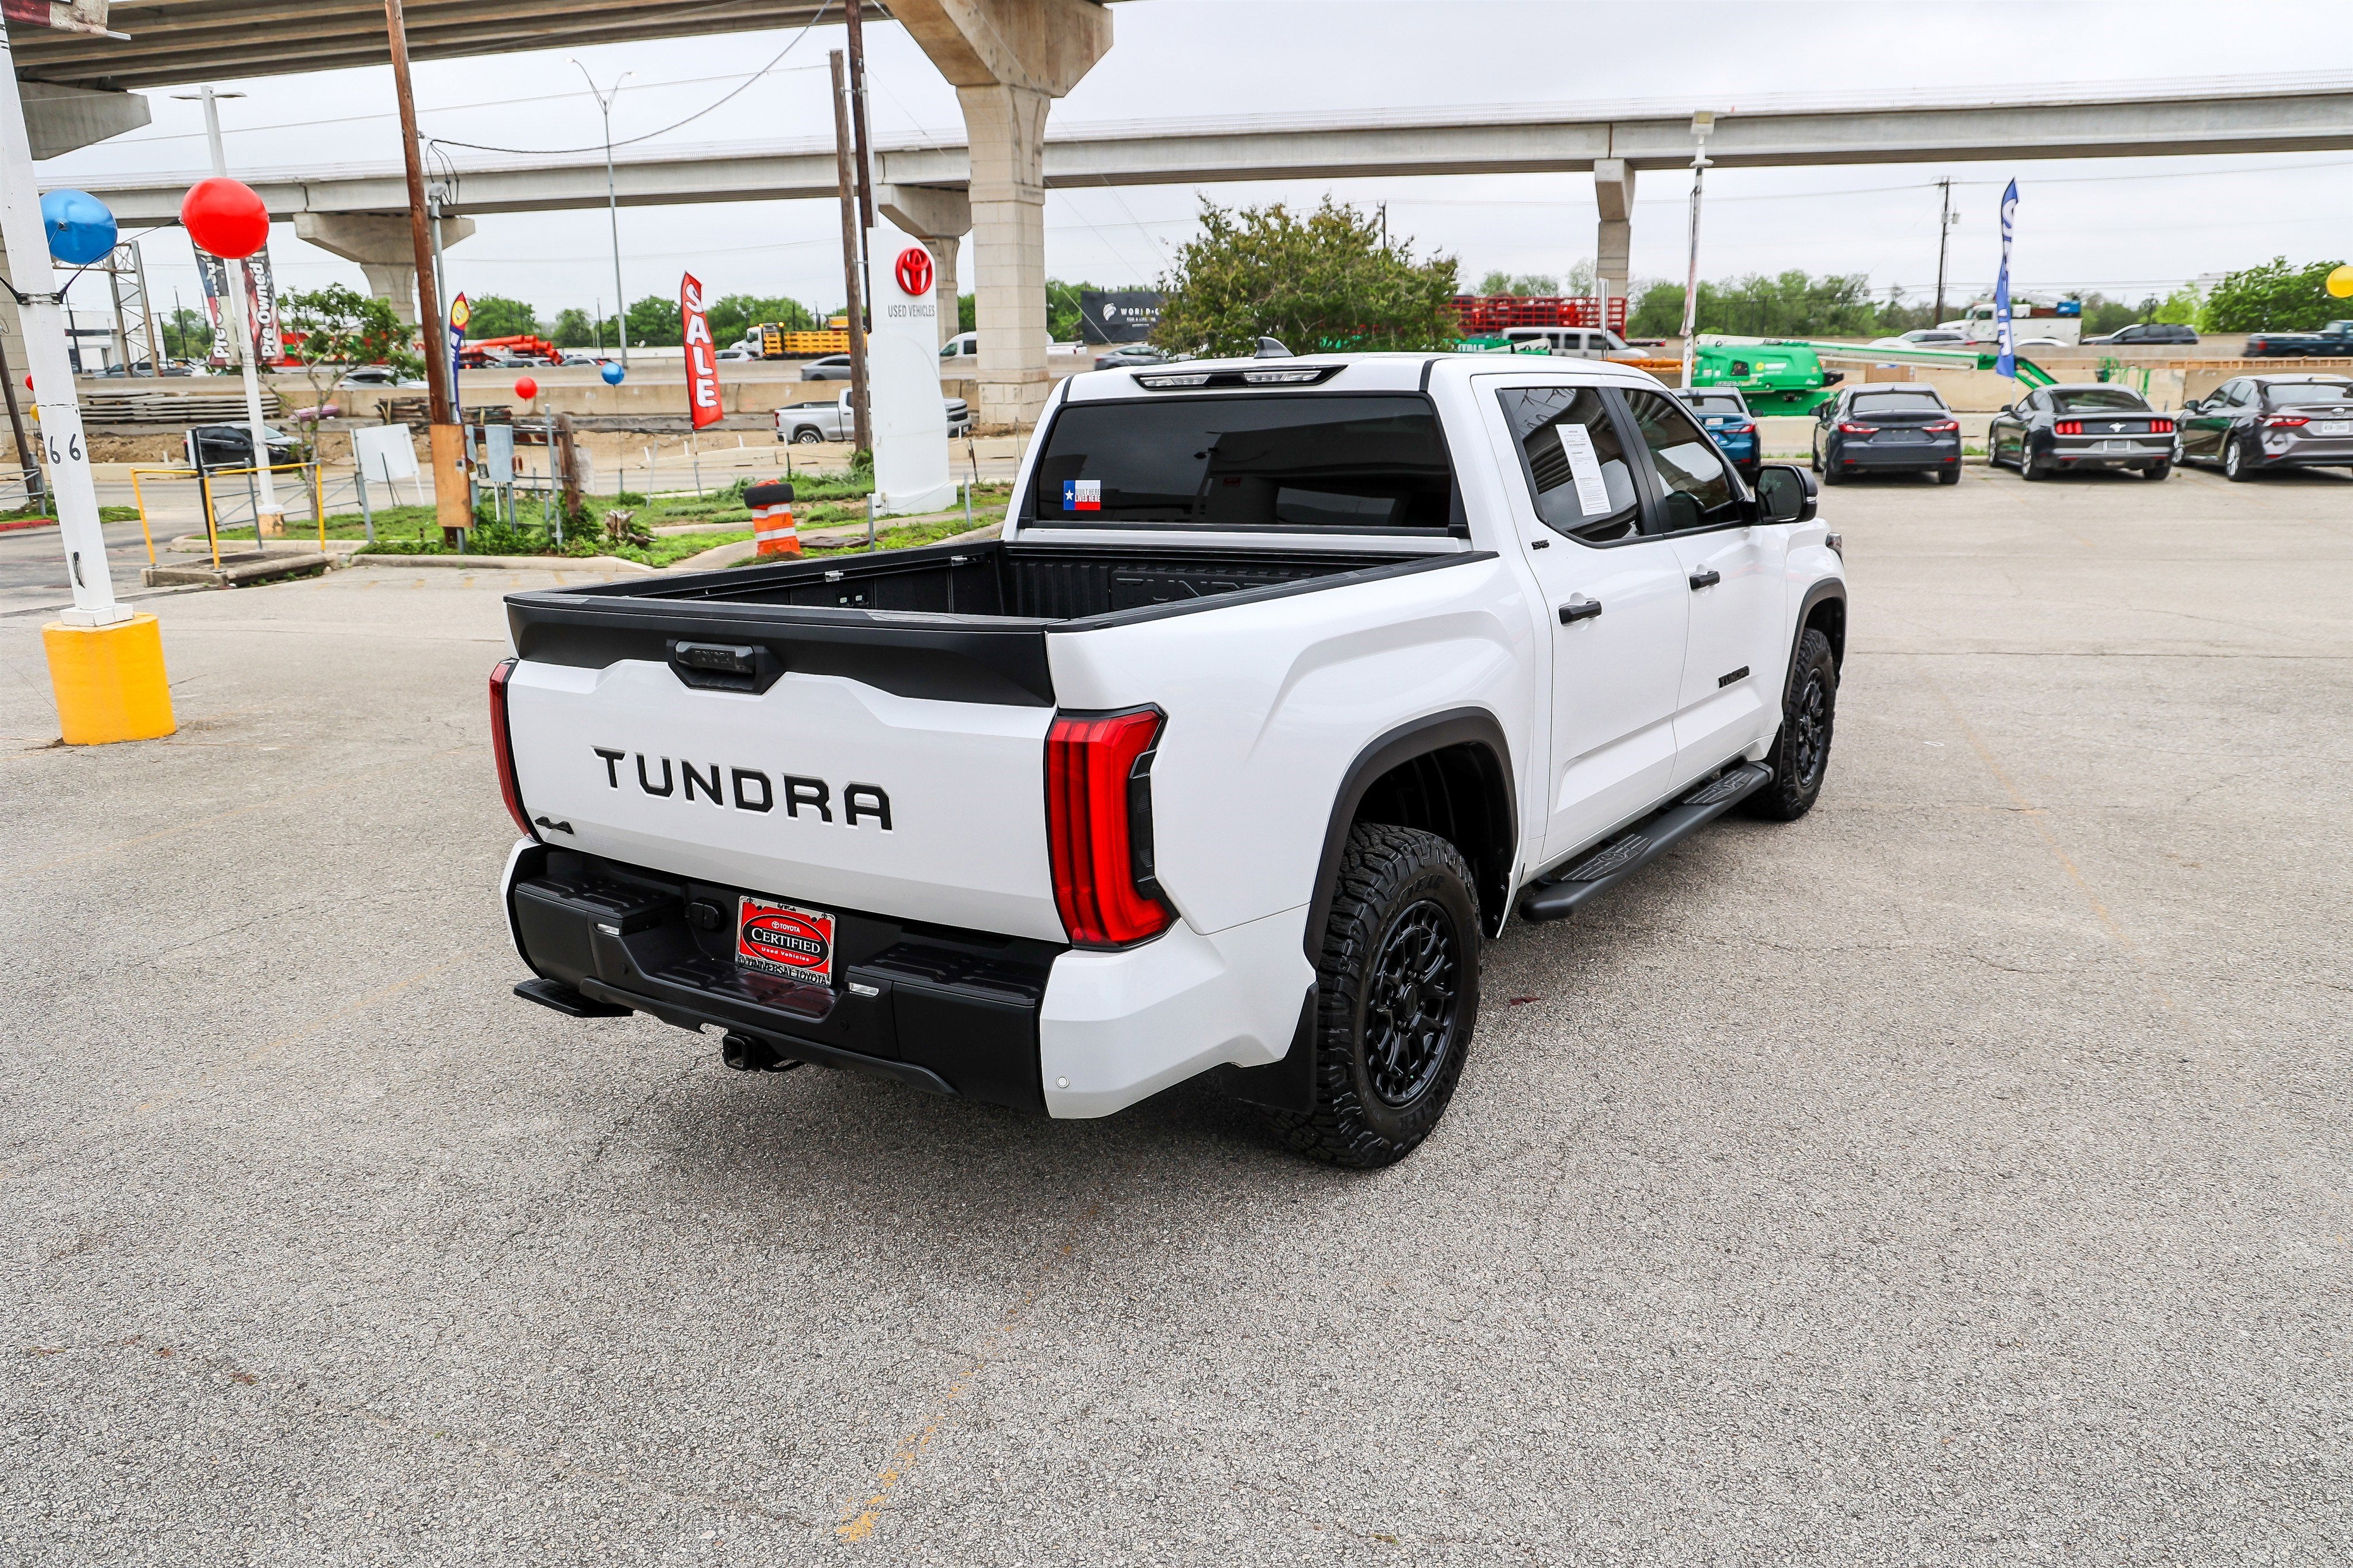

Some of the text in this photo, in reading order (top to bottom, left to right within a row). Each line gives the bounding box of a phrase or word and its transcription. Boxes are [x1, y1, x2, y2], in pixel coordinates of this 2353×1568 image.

[248, 262, 277, 357] Pre Owned
[888, 304, 935, 317] USED VEHICLES
[685, 283, 718, 408] SALE
[592, 747, 893, 832] TUNDRA
[751, 928, 820, 953] CERTIFIED
[780, 923, 800, 933] TOYOTA
[761, 947, 810, 962] Used Vehicles
[747, 957, 794, 976] UNIVERSAL
[795, 969, 830, 986] TOYOTA
